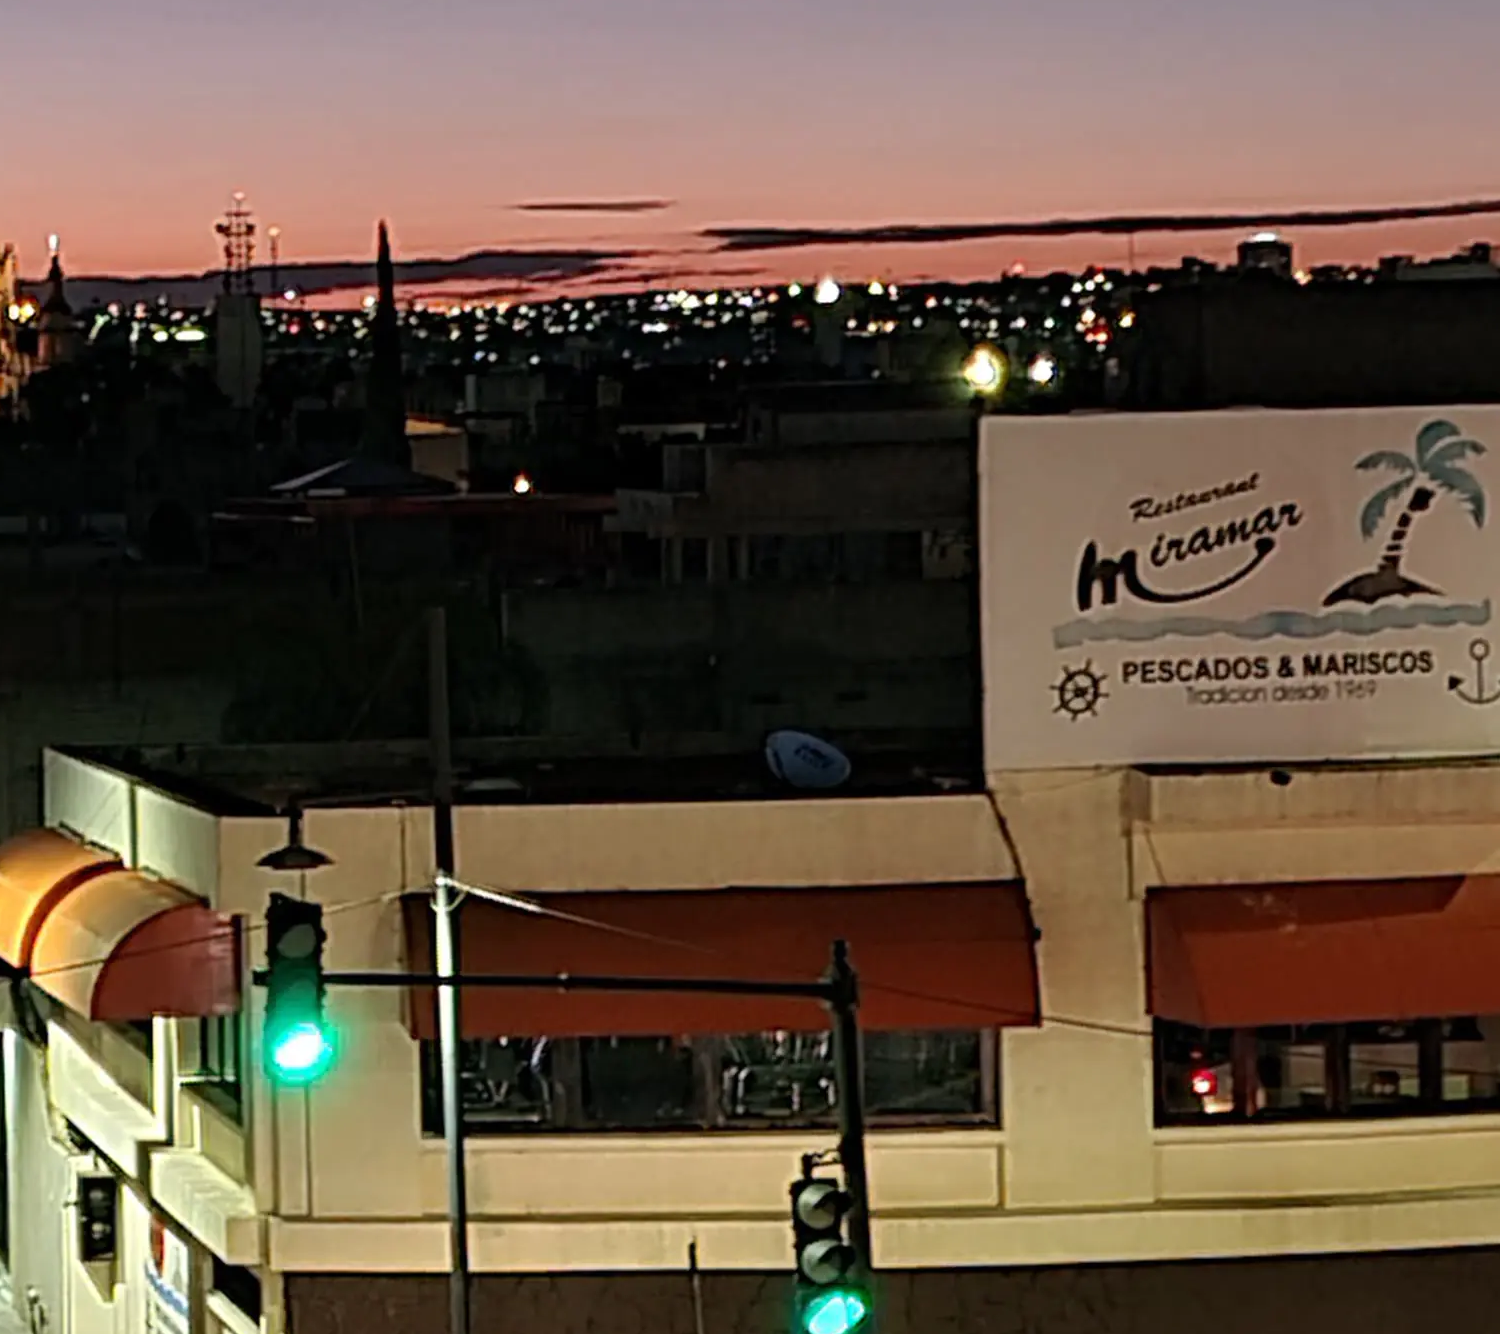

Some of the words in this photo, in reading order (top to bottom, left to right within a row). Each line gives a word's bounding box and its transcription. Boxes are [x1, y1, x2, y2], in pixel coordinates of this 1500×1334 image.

[1129, 472, 1260, 522] Restaurant
[1121, 657, 1269, 684] PESCADOS
[1277, 656, 1296, 678] &
[1303, 650, 1434, 677] MARISCOS
